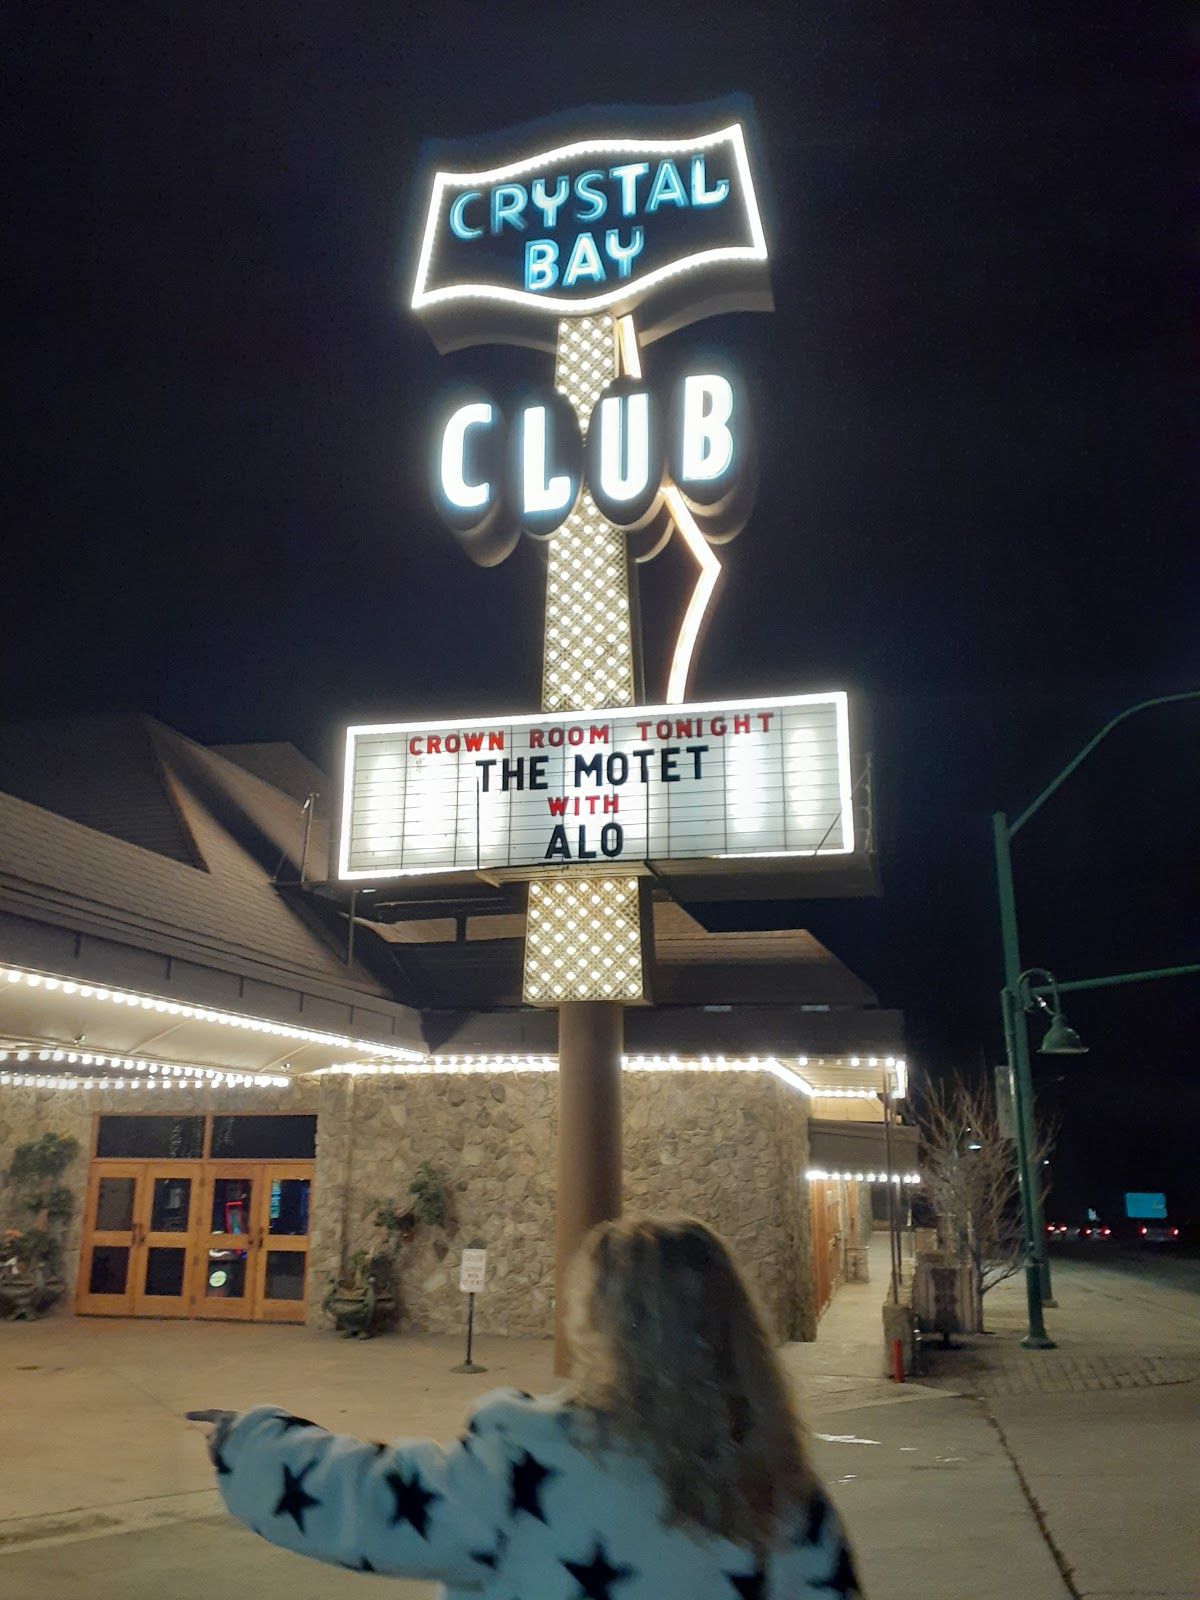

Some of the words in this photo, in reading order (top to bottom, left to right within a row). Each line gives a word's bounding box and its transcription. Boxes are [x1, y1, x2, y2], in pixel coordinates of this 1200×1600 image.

[449, 154, 730, 239] CRYSTAL
[523, 225, 645, 291] BAY
[440, 374, 734, 513] CLUB
[408, 730, 505, 756] CROWN
[529, 724, 610, 749] ROOM
[637, 712, 775, 741] TONIGHT
[476, 755, 549, 793] THE
[573, 745, 709, 788] MOTET
[547, 794, 620, 817] WITH
[544, 822, 624, 860] ALO
